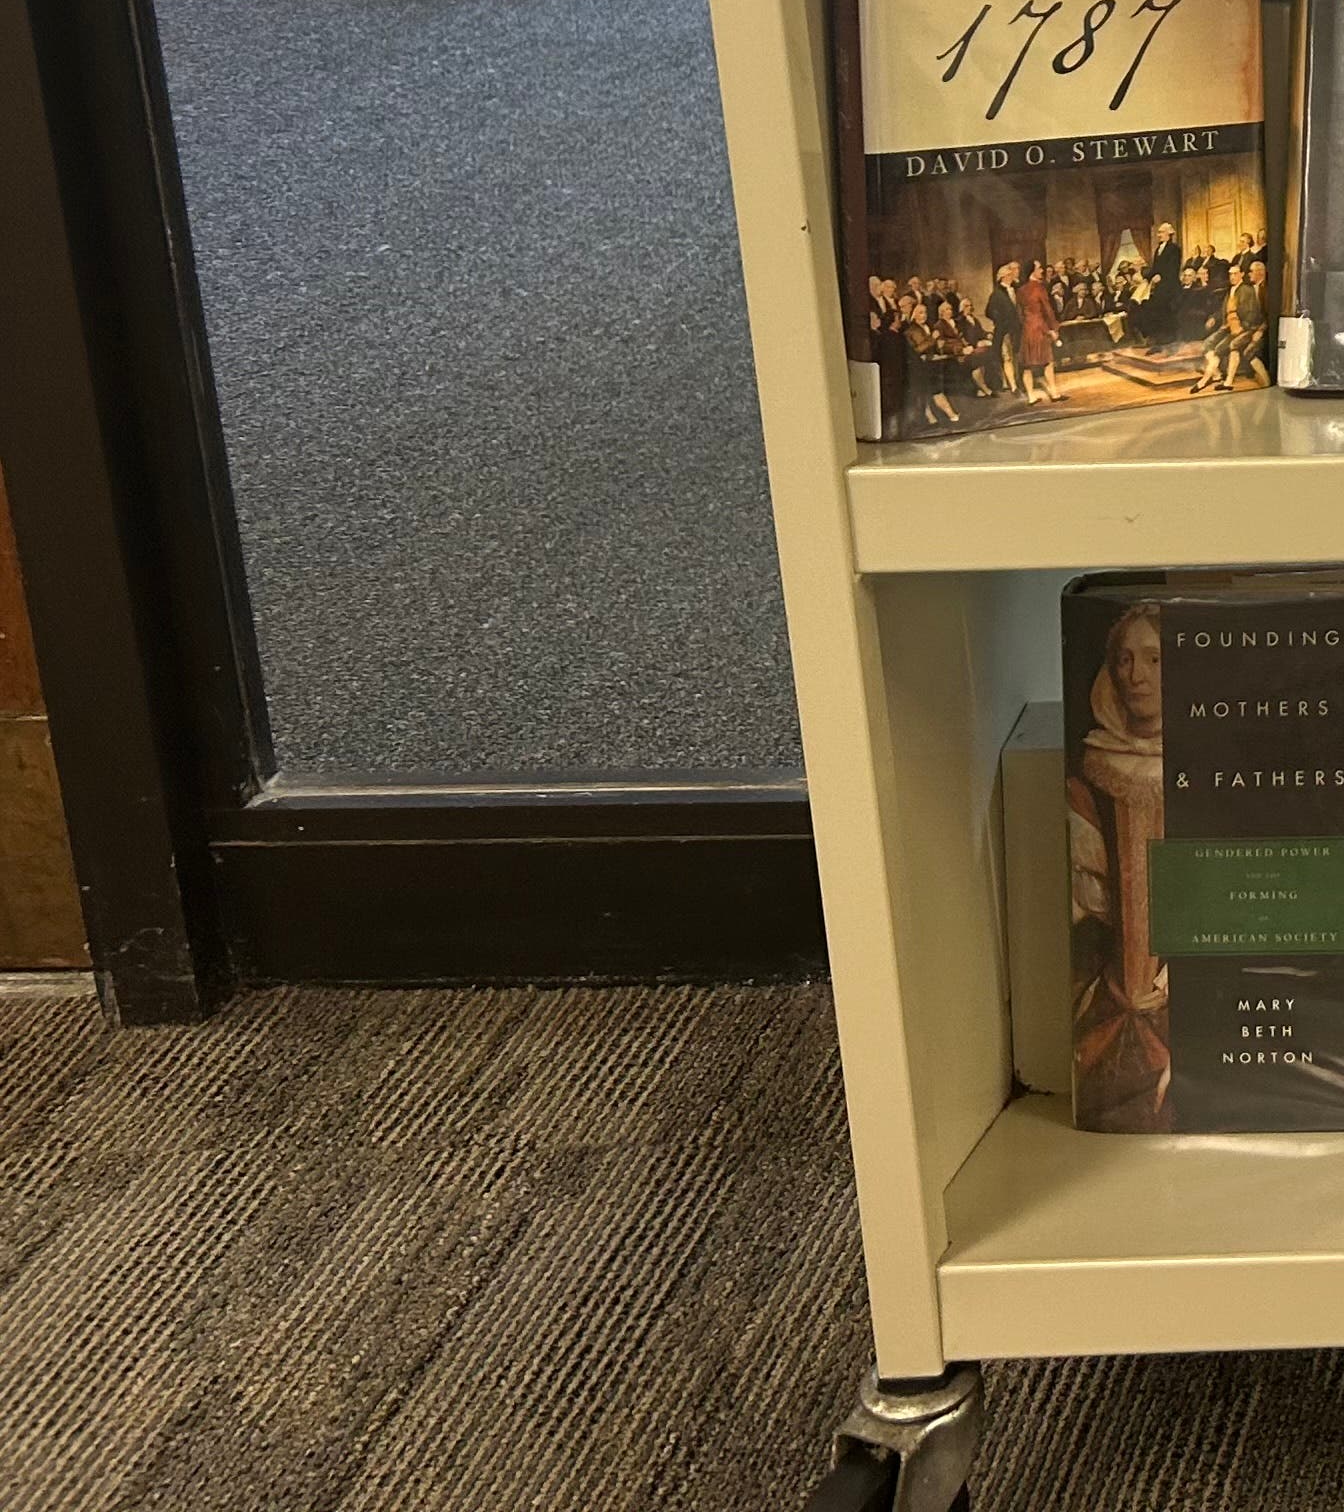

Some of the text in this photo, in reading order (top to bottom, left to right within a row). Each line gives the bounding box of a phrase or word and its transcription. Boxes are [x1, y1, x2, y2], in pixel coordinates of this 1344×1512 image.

[905, 129, 1221, 178] DAVID O. STEWART
[1176, 630, 1342, 649] FOUNDING
[1190, 699, 1330, 719] MOTHERS
[1176, 771, 1190, 788] &
[1195, 846, 1331, 859] GENDERED POWER
[1229, 890, 1299, 901] FORMING
[1192, 931, 1339, 943] AMERICAN SOCIETY
